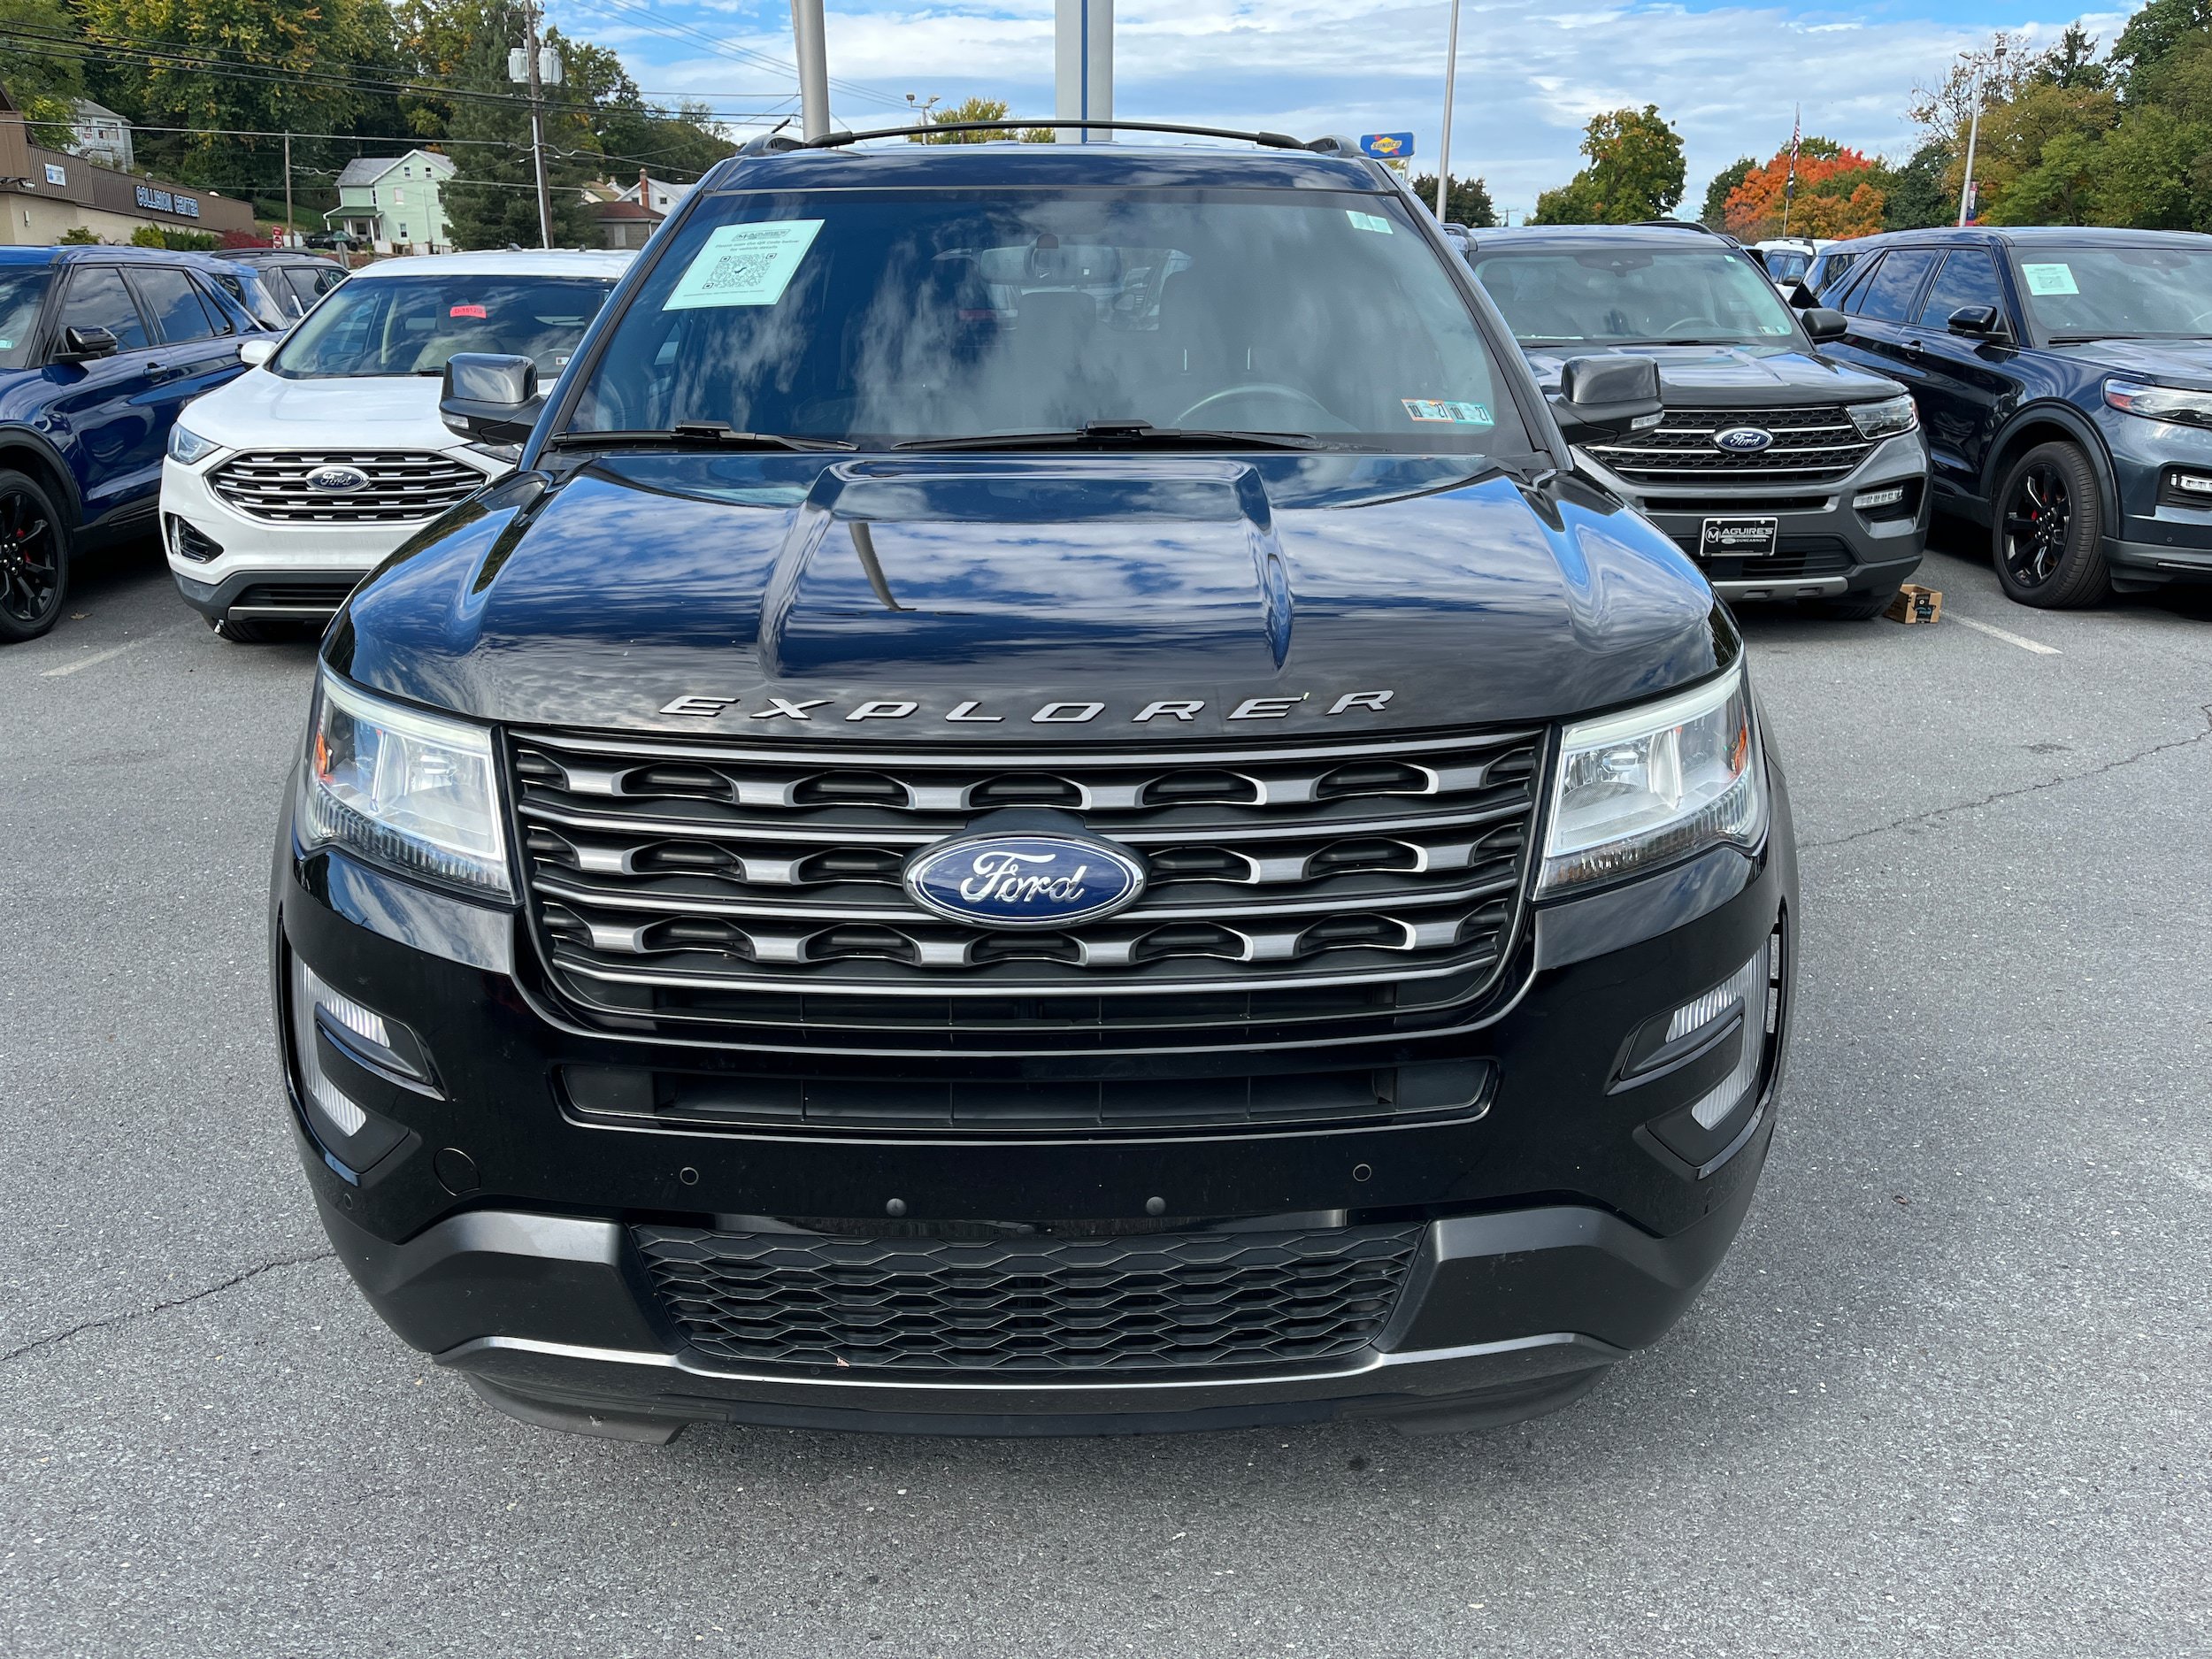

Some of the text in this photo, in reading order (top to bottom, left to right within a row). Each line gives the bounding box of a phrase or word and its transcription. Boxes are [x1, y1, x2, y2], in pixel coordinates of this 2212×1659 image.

[136, 185, 199, 218] COLLISION CENTER
[1730, 433, 1761, 447] Ford
[319, 472, 352, 486] Ford
[659, 687, 1394, 723] EXPLORER
[959, 850, 1087, 902] Ford
